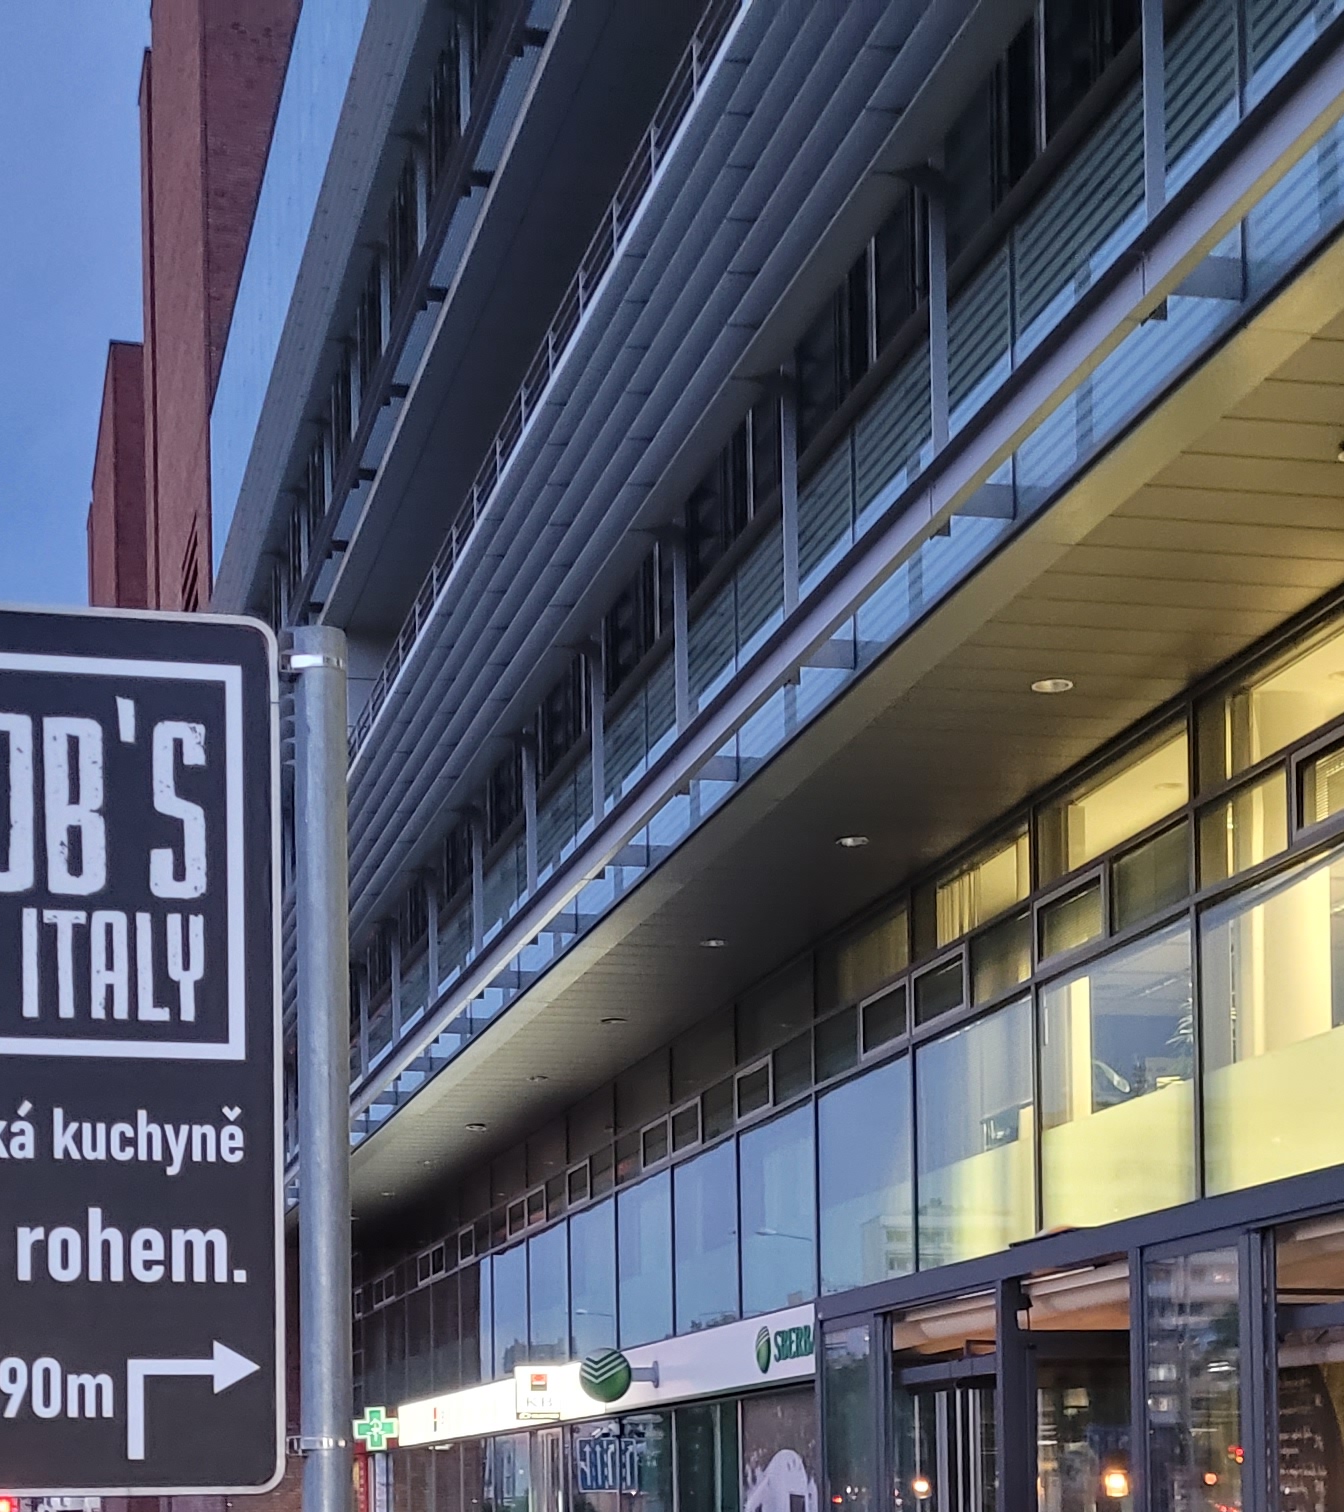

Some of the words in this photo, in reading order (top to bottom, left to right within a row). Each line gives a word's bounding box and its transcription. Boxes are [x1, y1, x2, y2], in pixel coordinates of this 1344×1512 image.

[22, 907, 205, 1022] ITALY
[53, 1105, 244, 1176] kuchyně
[17, 1207, 247, 1283] rohem.
